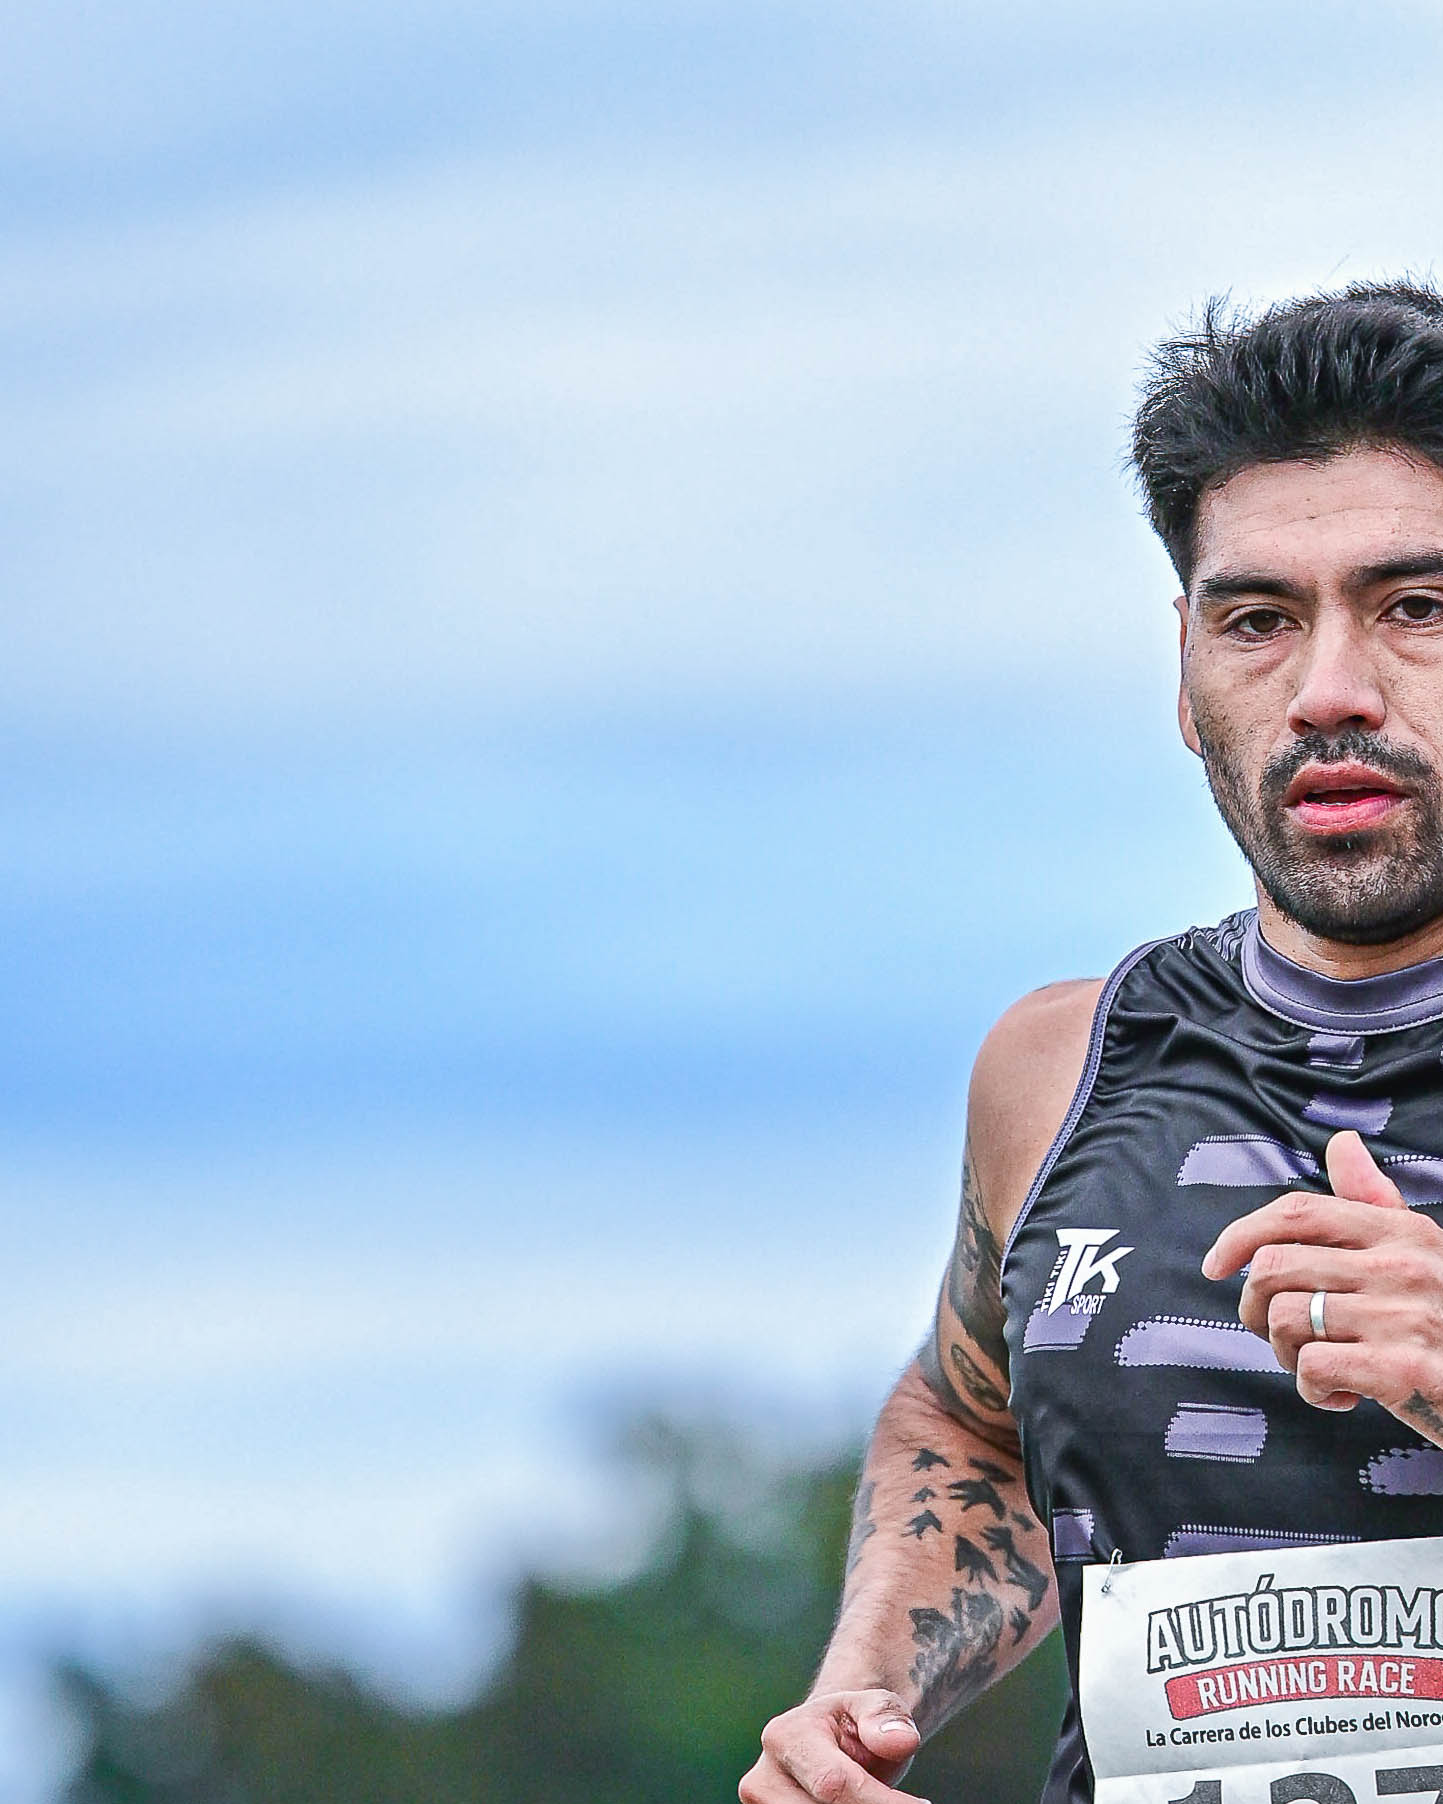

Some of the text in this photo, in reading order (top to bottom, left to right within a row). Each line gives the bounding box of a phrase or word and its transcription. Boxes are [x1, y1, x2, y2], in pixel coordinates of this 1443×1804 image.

[1041, 1250, 1068, 1312] TIKI TIKI
[1048, 1228, 1136, 1316] TK
[1070, 1294, 1107, 1315] SPORT
[1196, 1660, 1415, 1709] RUNNING RACE
[1146, 1729, 1167, 1747] La
[1170, 1727, 1235, 1746] Carrera
[1239, 1721, 1261, 1740] de
[1266, 1719, 1291, 1738] los
[1295, 1716, 1358, 1735] Clubes
[1362, 1711, 1391, 1732] del
